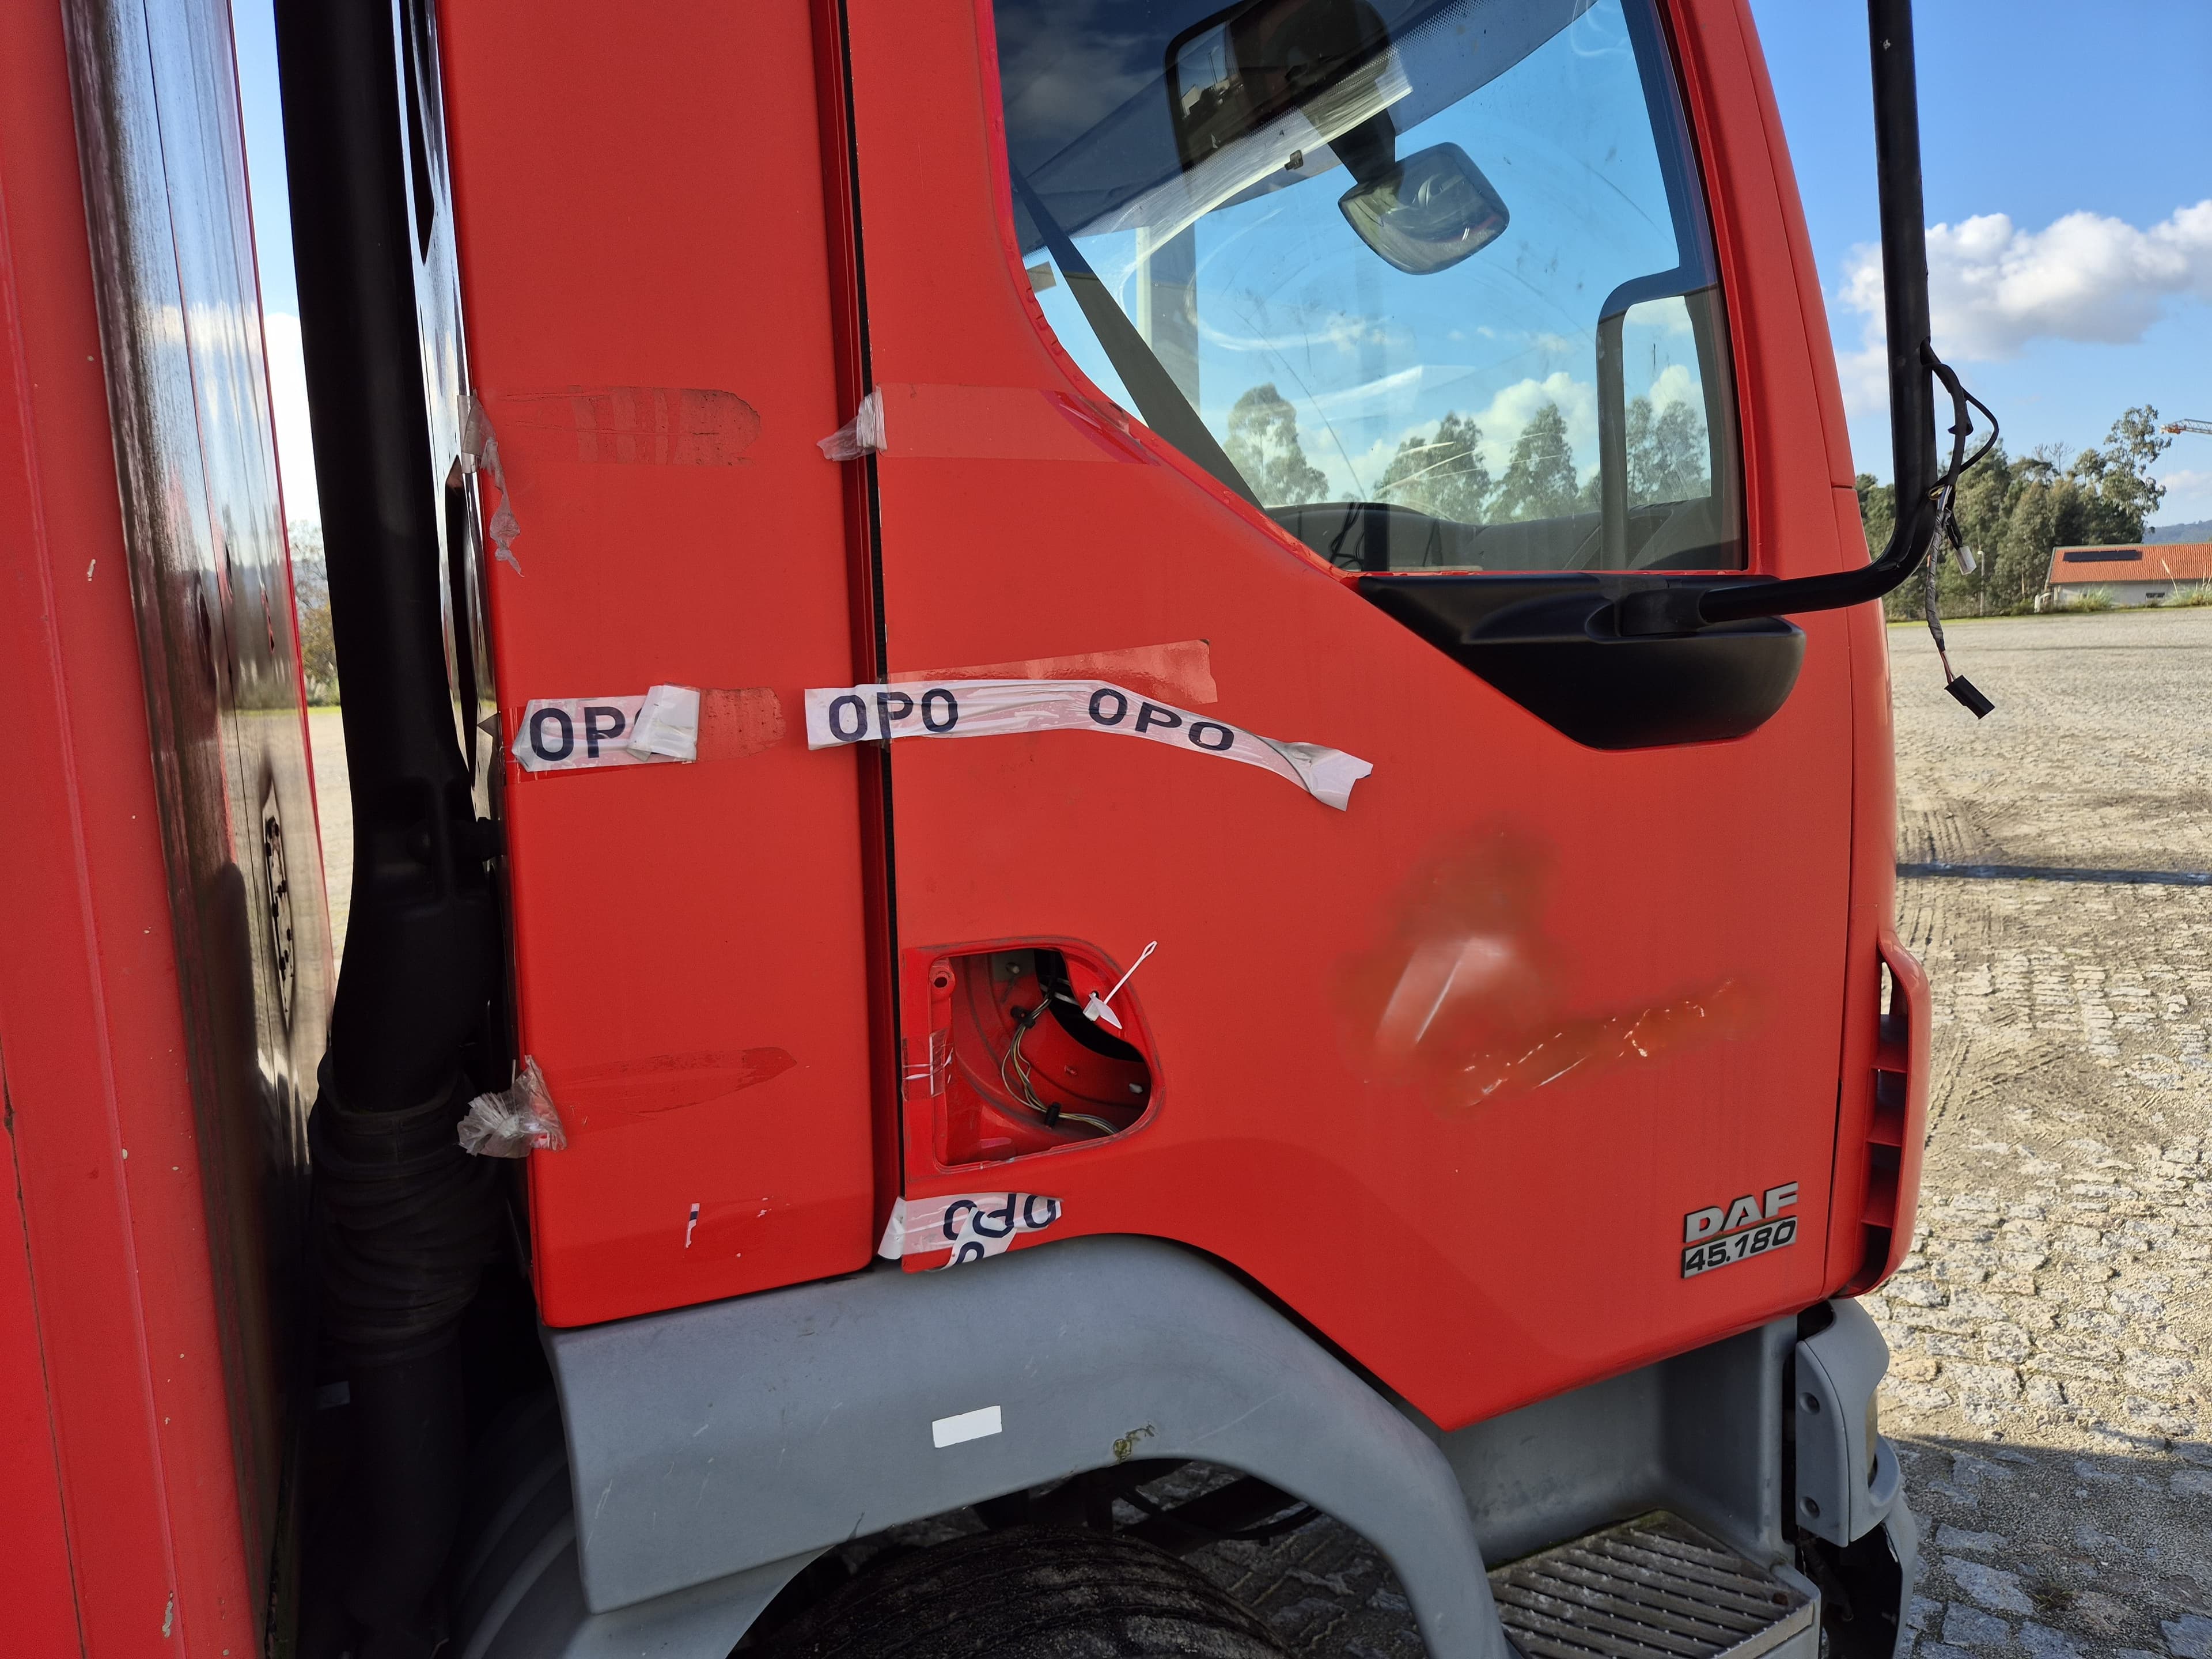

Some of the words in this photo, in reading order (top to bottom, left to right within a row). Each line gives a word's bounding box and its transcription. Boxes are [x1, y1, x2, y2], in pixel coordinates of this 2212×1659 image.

[529, 706, 660, 762] OP
[828, 688, 958, 742] OPO
[1088, 688, 1234, 751] OPO
[1683, 1181, 1798, 1243] DAF
[1685, 1220, 1796, 1271] 45.180
